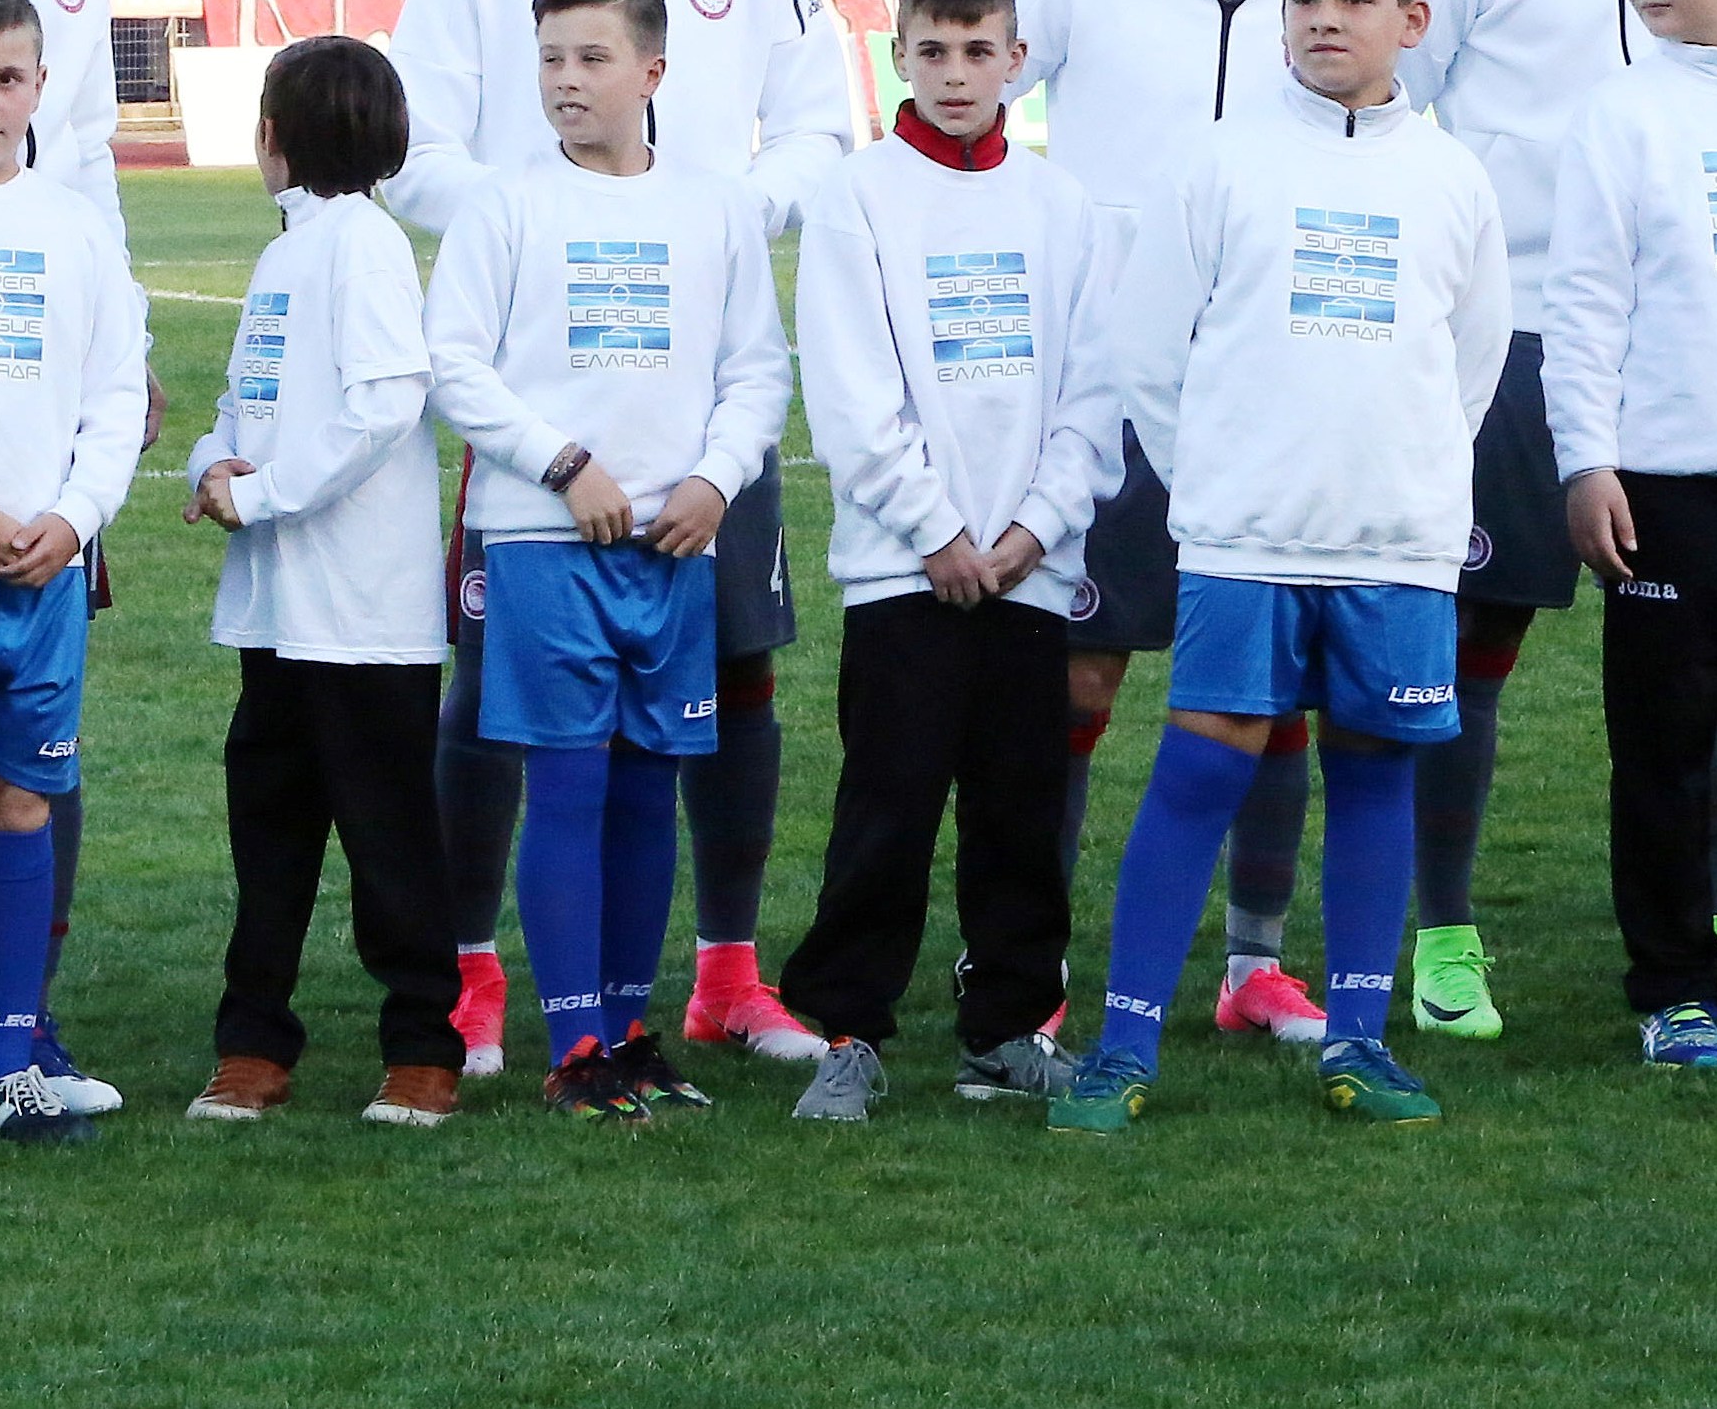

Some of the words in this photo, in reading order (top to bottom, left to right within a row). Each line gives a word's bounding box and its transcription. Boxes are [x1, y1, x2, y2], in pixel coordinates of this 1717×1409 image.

[1304, 232, 1389, 256] SUPER
[576, 266, 661, 282] SUPER
[936, 276, 1020, 296] SUPER
[1292, 275, 1396, 299] LEAGUE
[569, 308, 669, 325] LEAGUE
[931, 318, 1032, 339] LEAGUE
[1289, 319, 1393, 343] ΕΛΛΑΔΑ
[570, 353, 670, 370] ΕΛΛΑΔΑ
[936, 362, 1035, 384] ΕΛΛΑΔΑ
[1387, 684, 1455, 706] LEGEA
